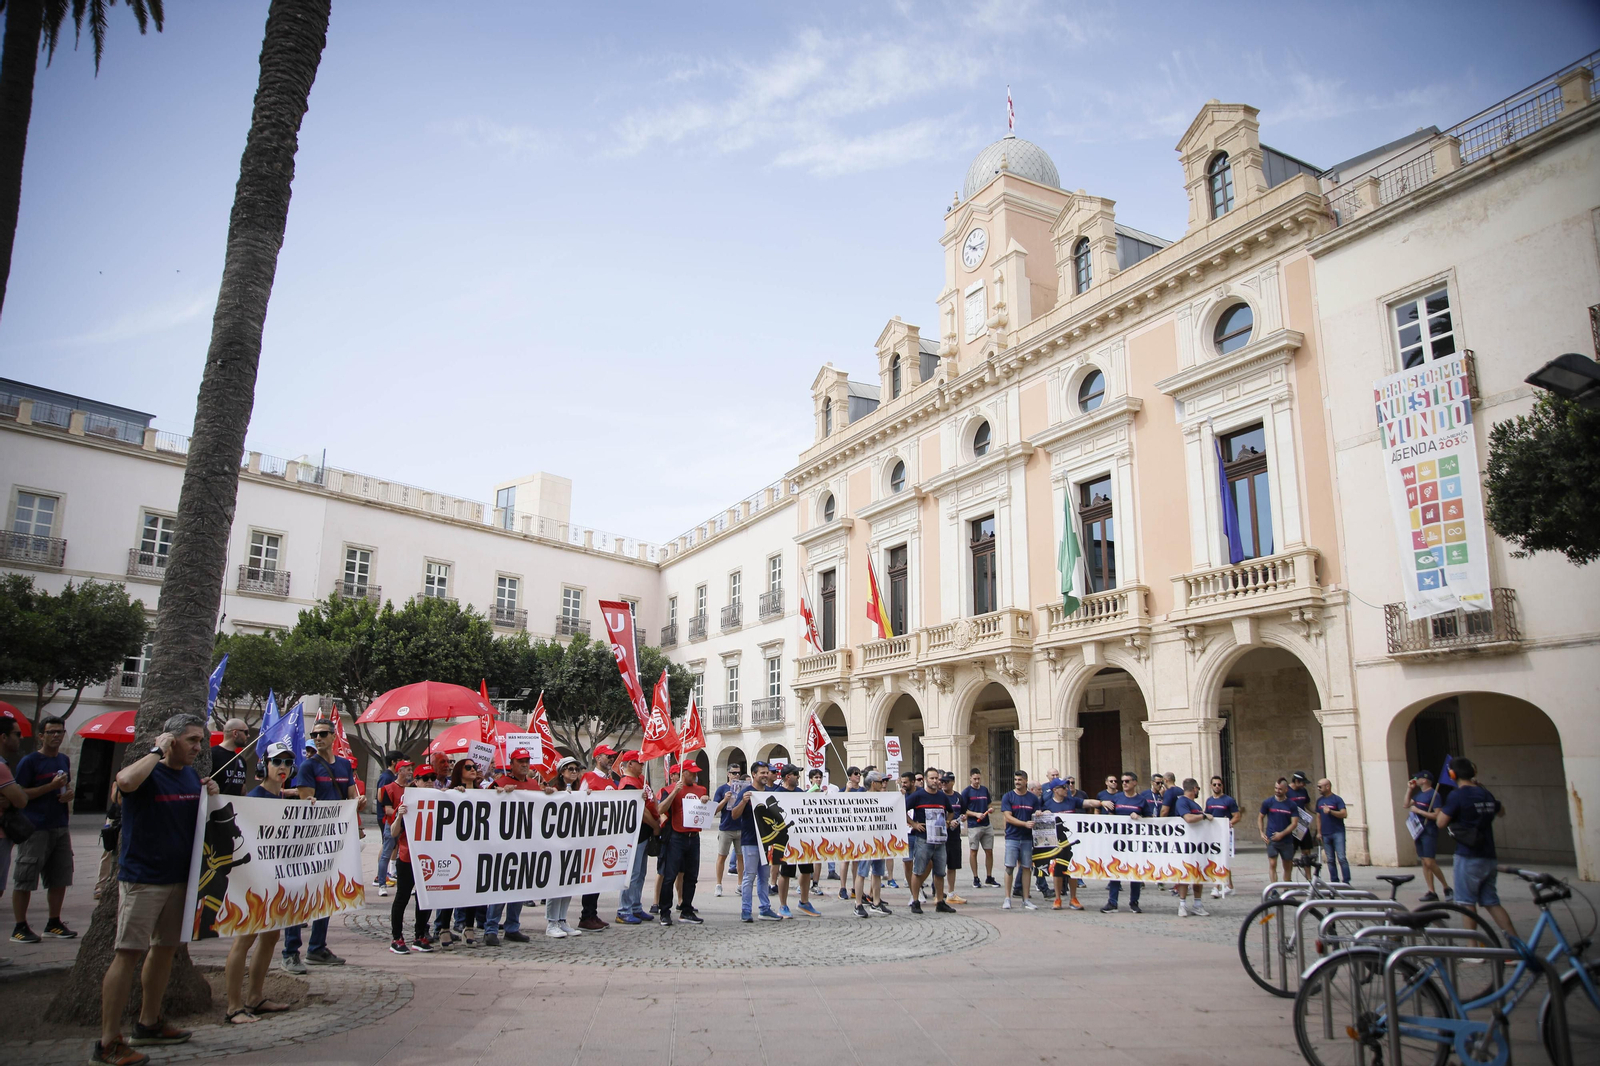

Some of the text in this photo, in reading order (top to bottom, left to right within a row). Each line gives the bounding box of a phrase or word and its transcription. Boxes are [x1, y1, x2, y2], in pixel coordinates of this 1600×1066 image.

[1377, 359, 1463, 402] TRANSFORMA
[1376, 375, 1466, 423] NUESTRO
[1380, 401, 1467, 450] MUNDO
[1391, 435, 1469, 464] AGENDA 2030
[474, 744, 493, 754] JORNADA
[819, 798, 879, 806] INSTALACIONES
[282, 803, 343, 820] SIN INVERSIÓN
[499, 801, 535, 840] UN
[541, 799, 638, 840] CONVENIO
[827, 814, 873, 823] VERGÜENZA
[256, 824, 275, 840] NO
[275, 825, 290, 840] SE
[292, 824, 322, 840] PUEDE
[321, 822, 336, 838] DAR
[793, 826, 855, 834] AYUNTAMIENTO
[868, 822, 898, 831] ALMERÍA
[1076, 821, 1186, 837] BOMBEROS
[257, 844, 304, 860] SERVICIO
[304, 842, 316, 857] DE
[1113, 840, 1222, 855] QUEMADOS
[275, 864, 286, 880] AL
[475, 850, 551, 894] DIGNO
